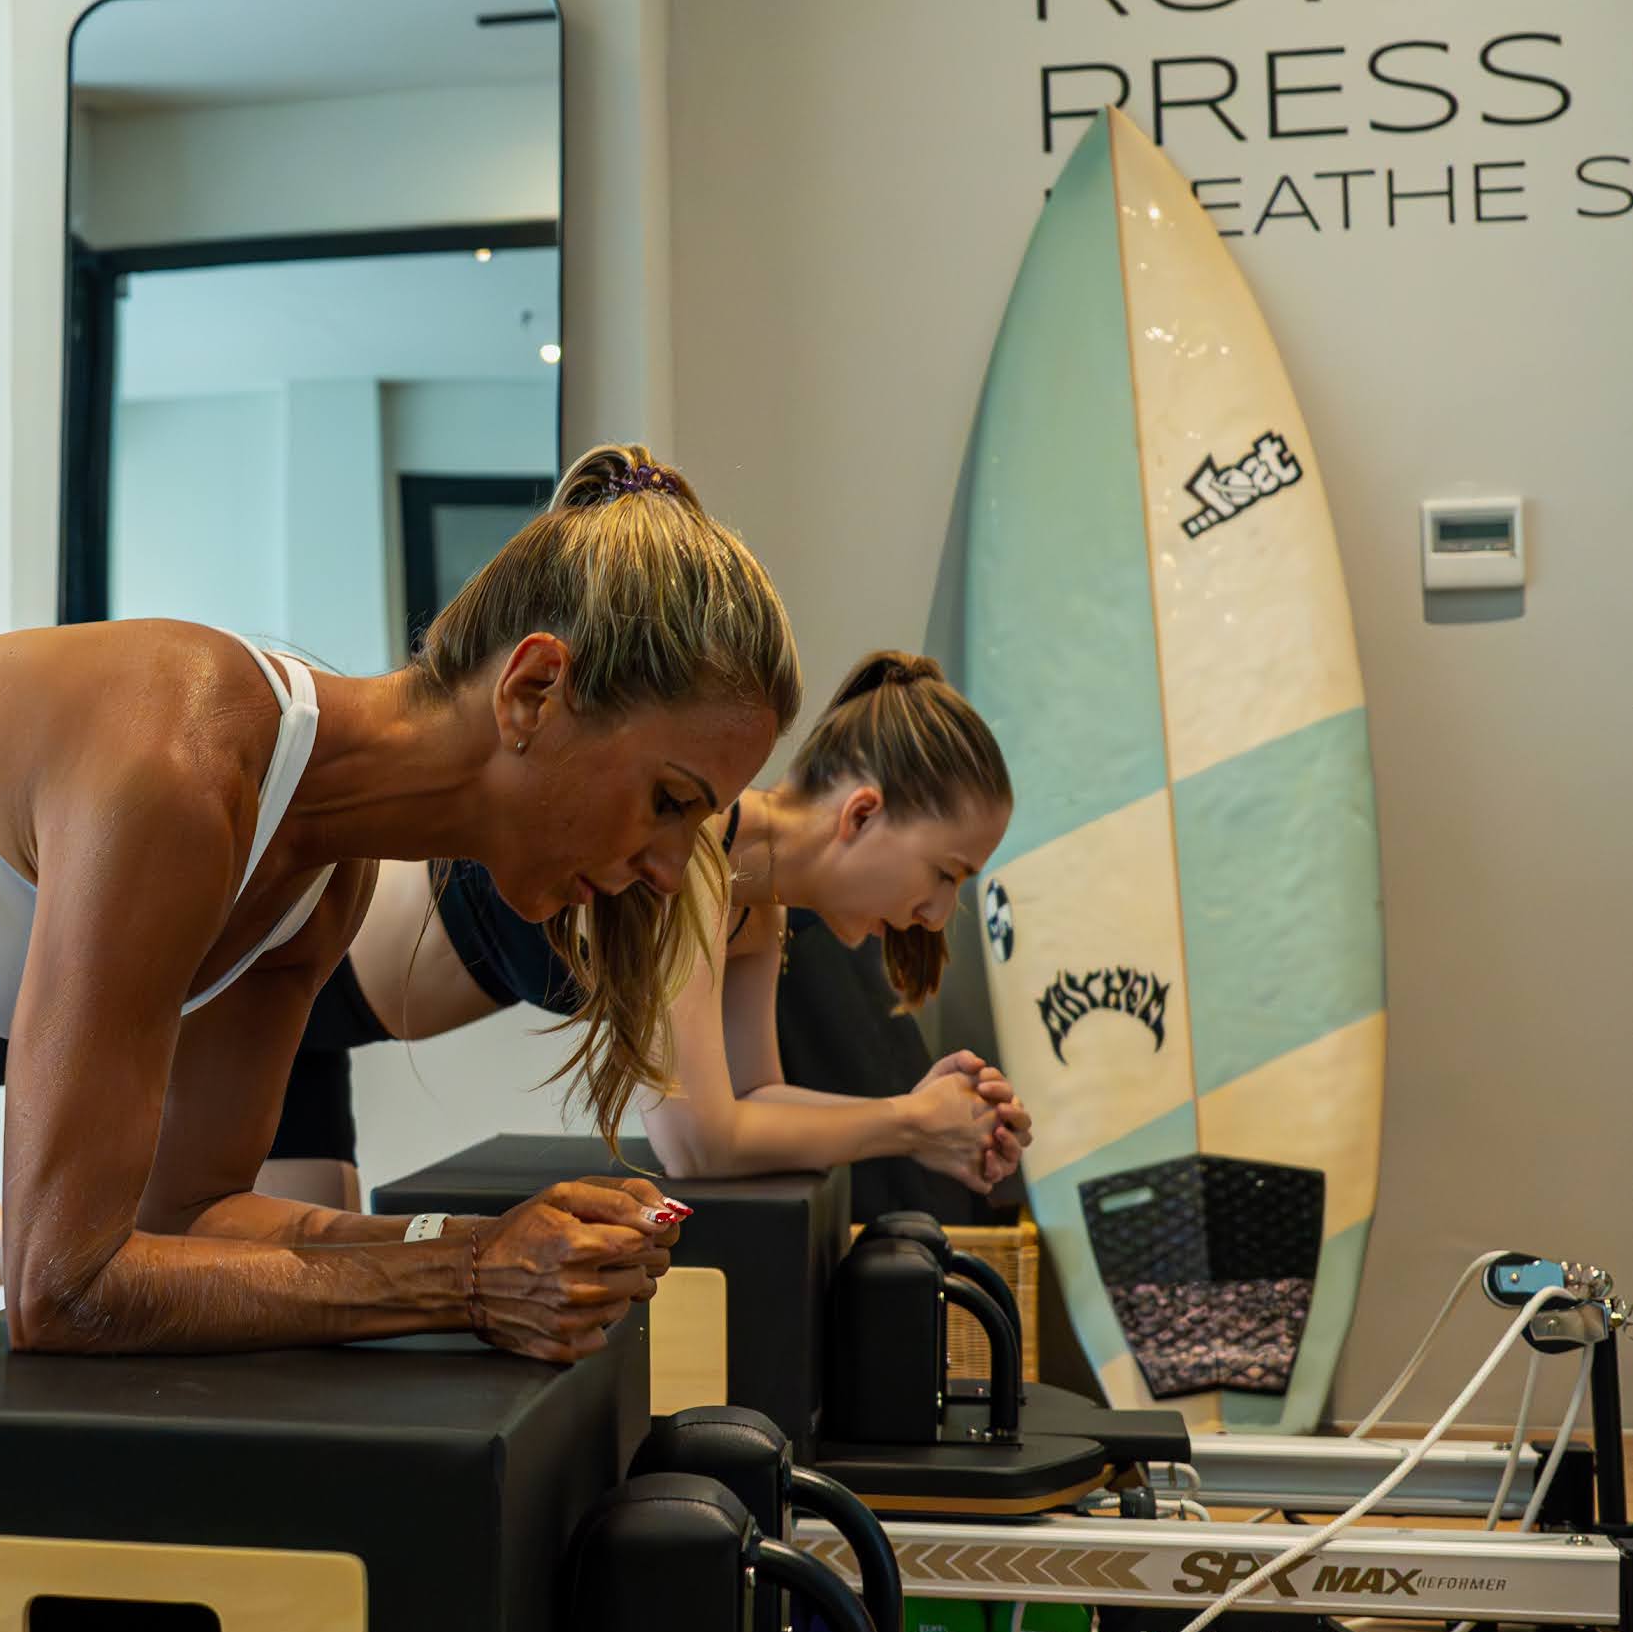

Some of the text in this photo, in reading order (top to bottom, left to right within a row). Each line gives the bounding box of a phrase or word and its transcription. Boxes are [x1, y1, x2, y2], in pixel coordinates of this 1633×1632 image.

[1041, 32, 1571, 153] PRESS
[1044, 160, 1528, 237] EATHE
[1172, 1549, 1508, 1598] SPX MAX REFORMER
